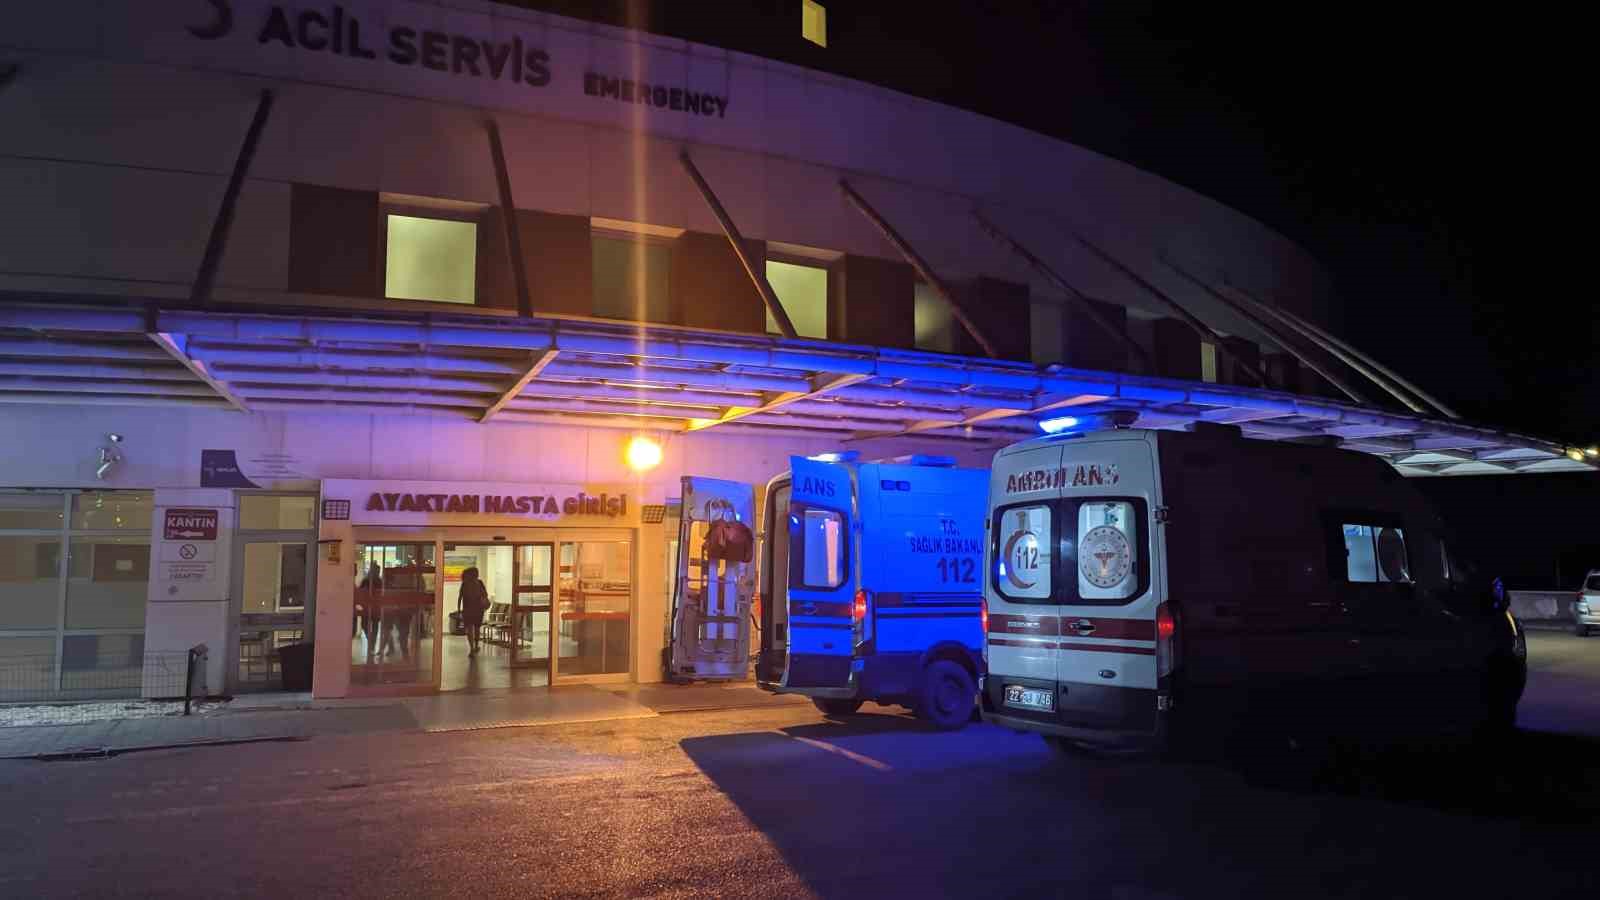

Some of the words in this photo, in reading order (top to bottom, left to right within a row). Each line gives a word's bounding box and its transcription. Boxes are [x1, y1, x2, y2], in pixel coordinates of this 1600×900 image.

[257, 5, 377, 60] ACİL
[387, 25, 552, 88] SERVİS
[583, 72, 729, 119] EMERGENCY
[366, 492, 481, 513] AYAKTAN
[484, 495, 560, 514] HASTA
[563, 492, 628, 517] GİRİŞİ
[936, 556, 977, 584] 112
[1015, 547, 1039, 570] 112
